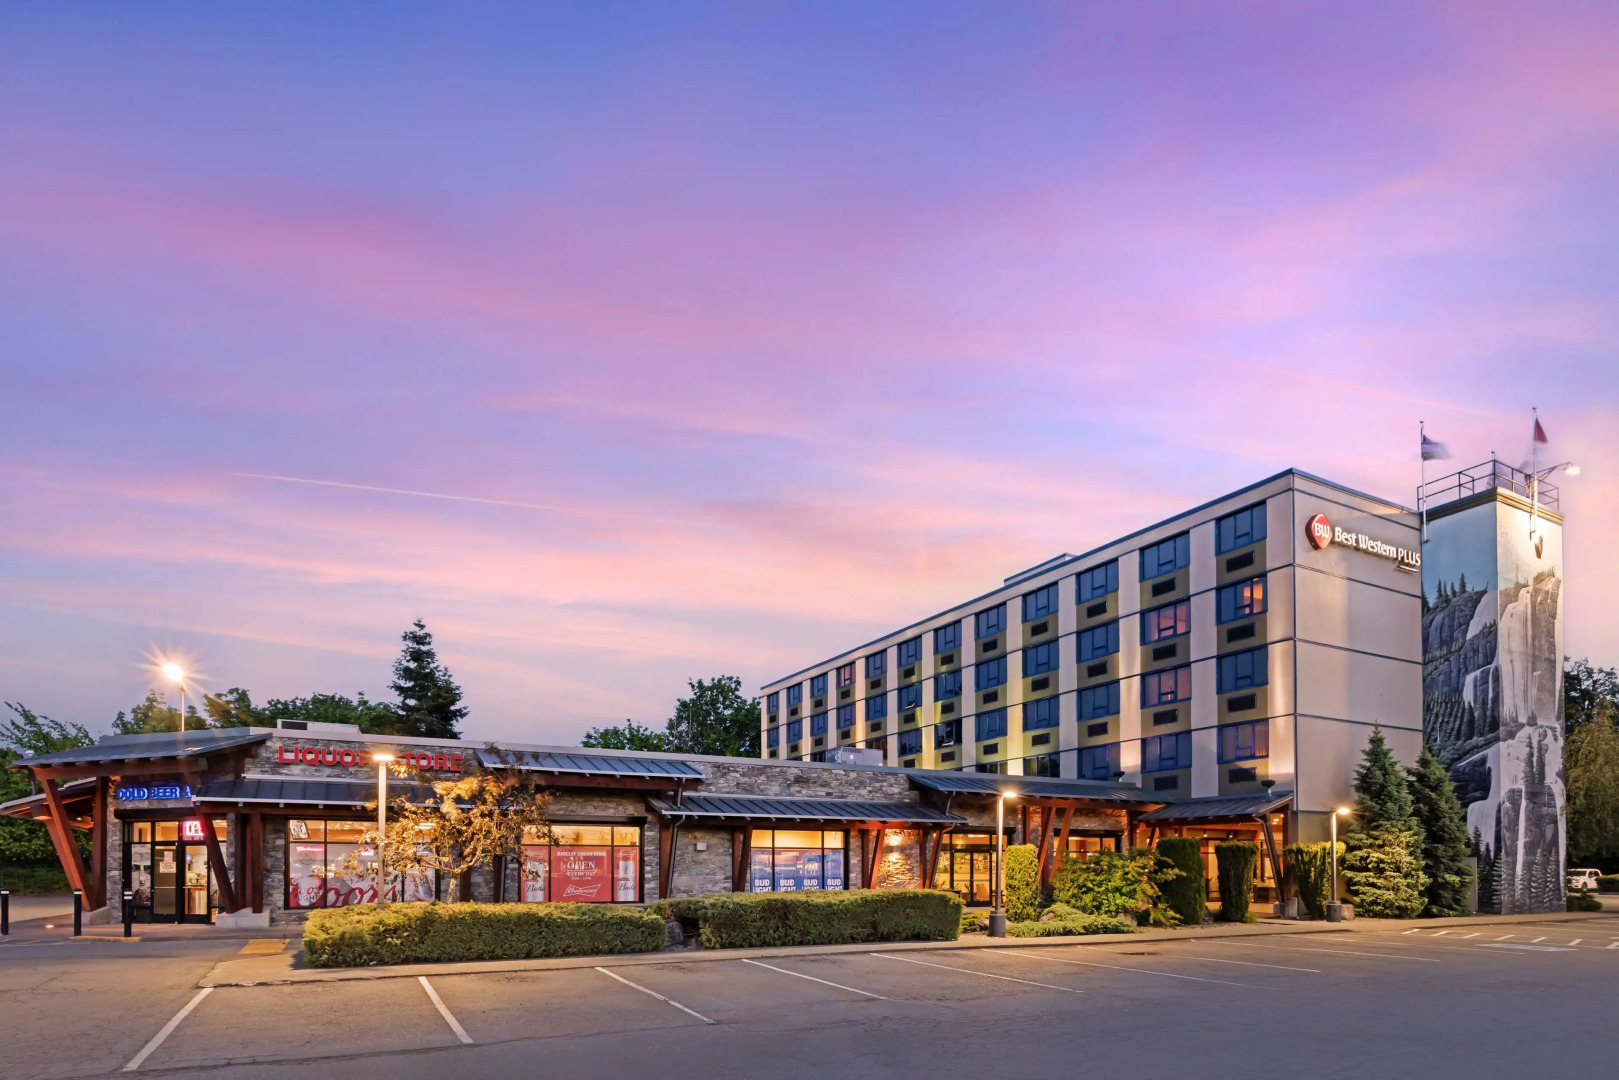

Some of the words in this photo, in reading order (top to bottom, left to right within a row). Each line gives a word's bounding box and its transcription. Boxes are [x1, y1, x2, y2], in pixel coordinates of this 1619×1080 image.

[1314, 523, 1330, 538] BW
[1334, 526, 1357, 548] Best
[1358, 533, 1397, 559] Western
[1397, 547, 1421, 566] PLUS
[392, 751, 465, 772] TORE
[119, 787, 149, 801] COLD
[151, 786, 181, 800] BEER
[567, 861, 595, 870] OPEN
